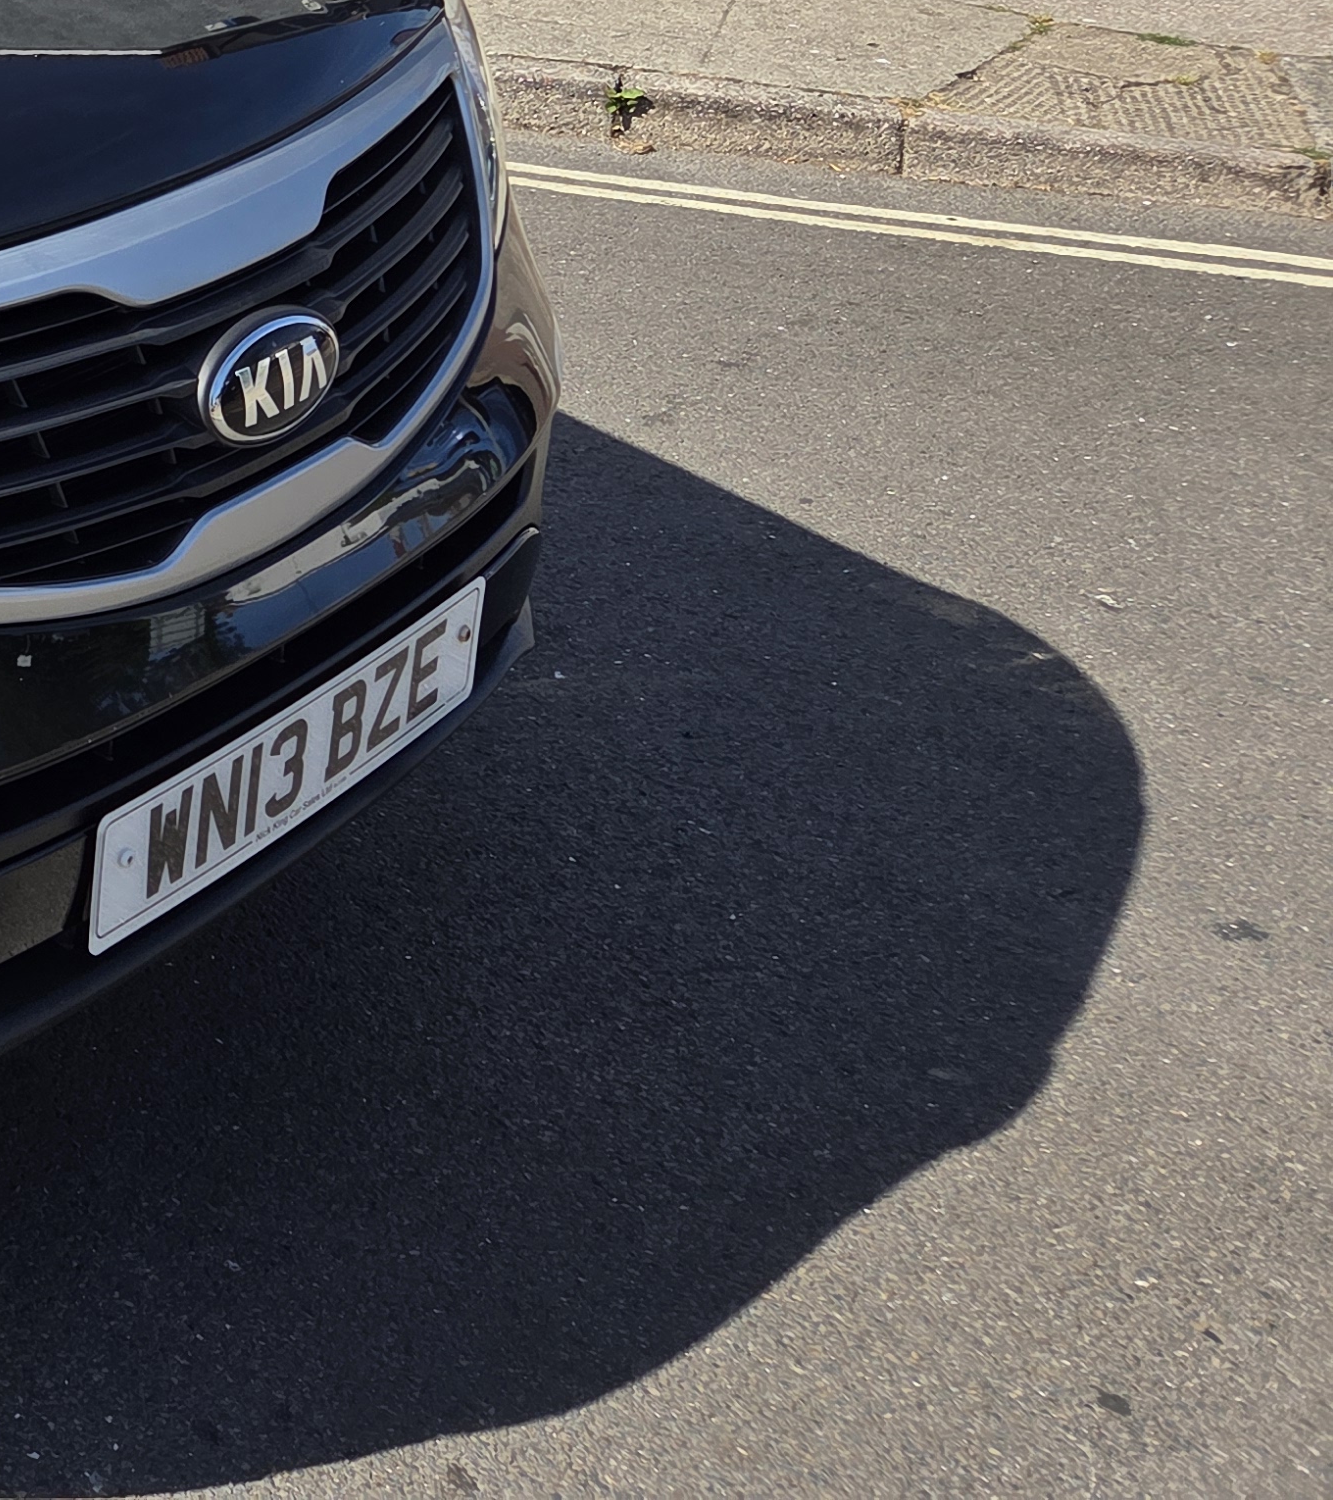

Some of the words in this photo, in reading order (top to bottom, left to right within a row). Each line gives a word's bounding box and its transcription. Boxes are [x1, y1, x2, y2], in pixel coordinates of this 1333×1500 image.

[235, 335, 327, 428] KIA
[146, 717, 309, 900] WN13
[323, 618, 448, 784] BZE
